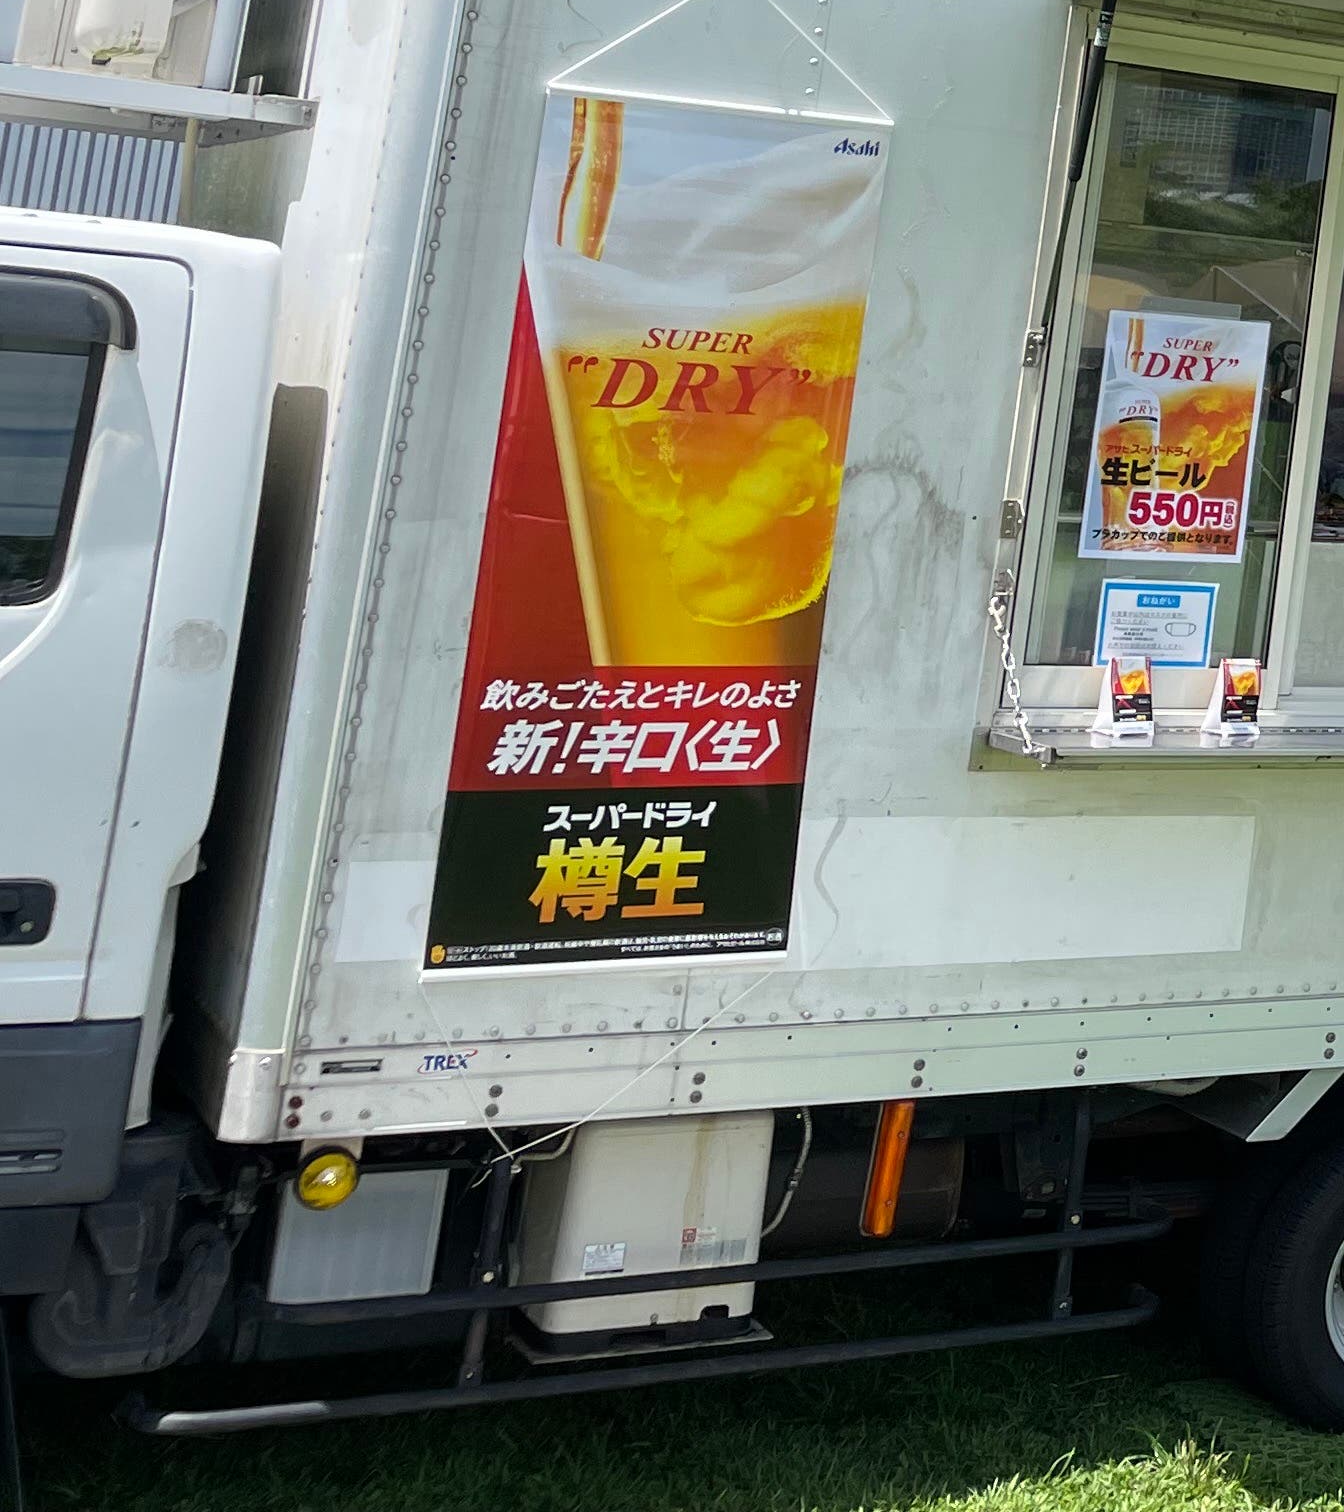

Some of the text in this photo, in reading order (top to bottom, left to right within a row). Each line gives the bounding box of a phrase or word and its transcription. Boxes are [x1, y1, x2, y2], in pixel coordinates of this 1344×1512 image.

[833, 137, 880, 159] Asahi
[641, 327, 754, 355] SUPER
[1163, 337, 1213, 353] SUPER
[1100, 458, 1207, 488] 生ビール
[1128, 491, 1224, 528] 550円
[480, 679, 801, 711] 飲みごたえとキレのよさ
[542, 801, 717, 832] スーパードライ
[529, 836, 705, 923] 樽生
[423, 1055, 469, 1071] TREX
